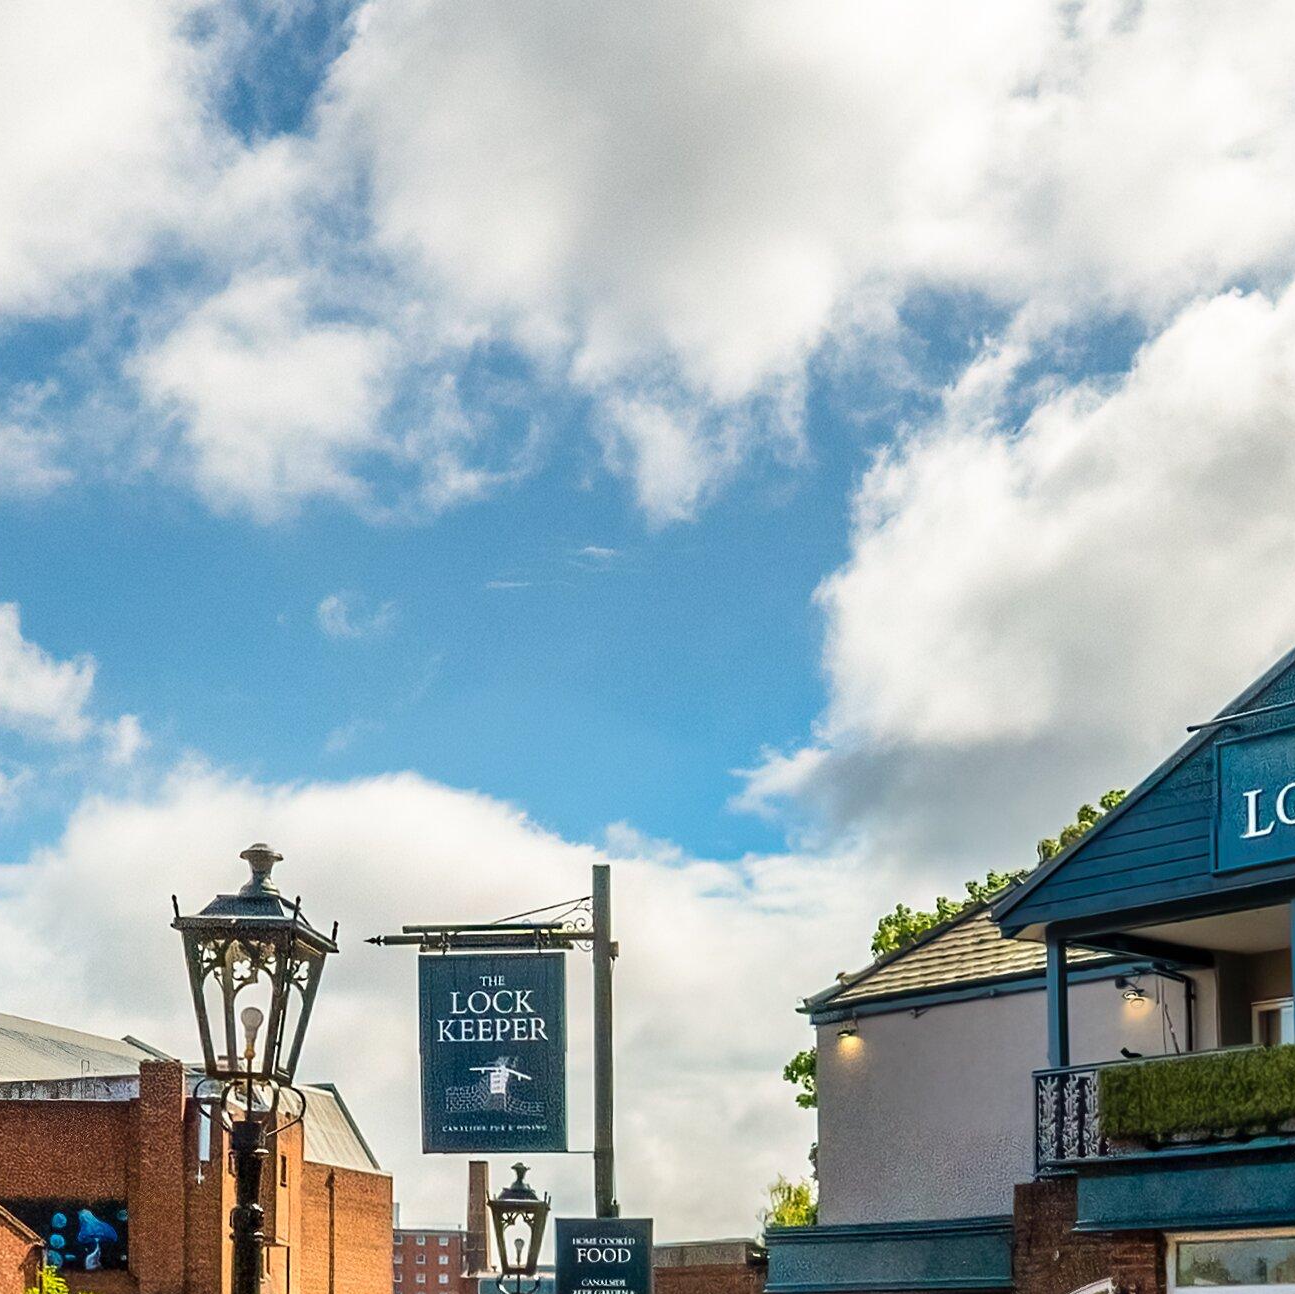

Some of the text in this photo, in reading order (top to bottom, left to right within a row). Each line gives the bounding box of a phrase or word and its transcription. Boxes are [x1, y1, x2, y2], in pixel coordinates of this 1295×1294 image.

[479, 975, 506, 987] THE
[449, 989, 535, 1014] LOCK
[437, 1017, 549, 1042] KEEPER
[572, 1237, 636, 1245] HOME COOKED
[577, 1248, 631, 1263] FOOD
